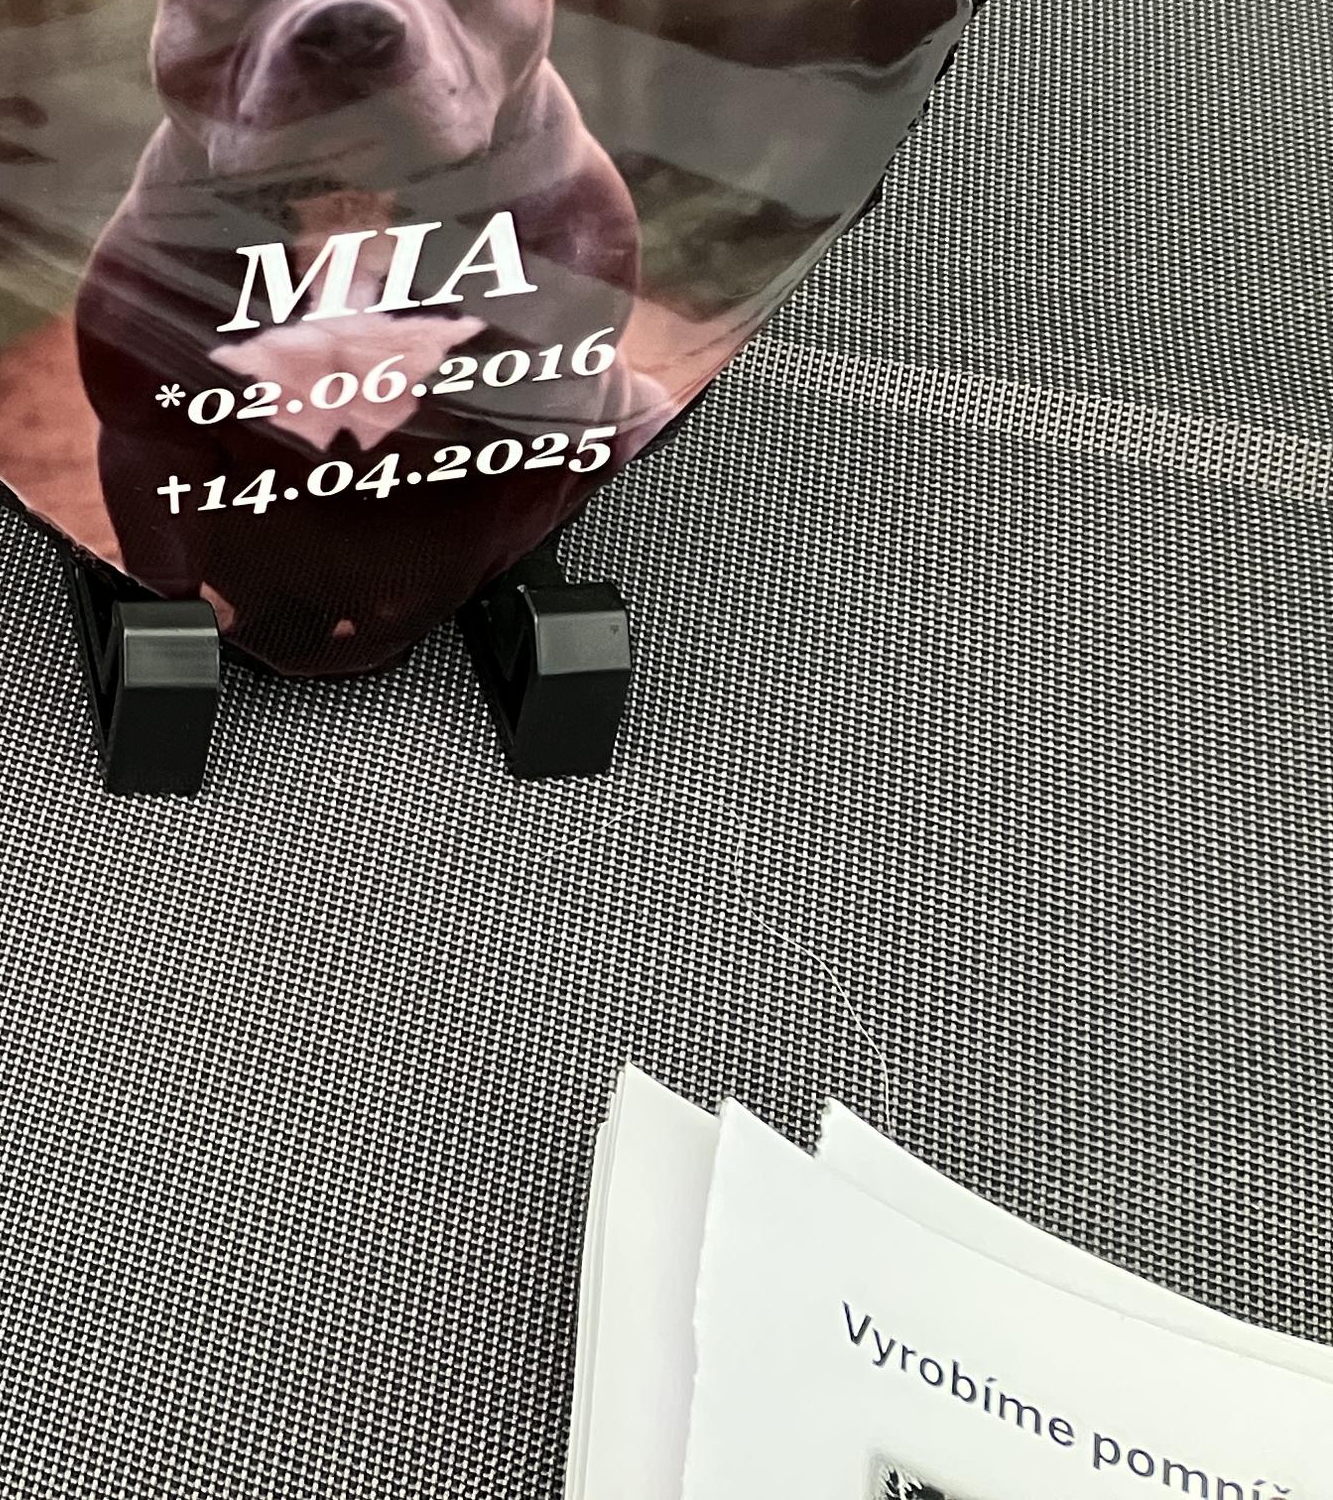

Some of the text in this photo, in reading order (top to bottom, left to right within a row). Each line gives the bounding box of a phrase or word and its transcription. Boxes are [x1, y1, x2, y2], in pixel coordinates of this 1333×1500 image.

[216, 211, 538, 333] MIA
[157, 426, 618, 515] †14.04.2025
[842, 1300, 1076, 1448] Vyrobíme
